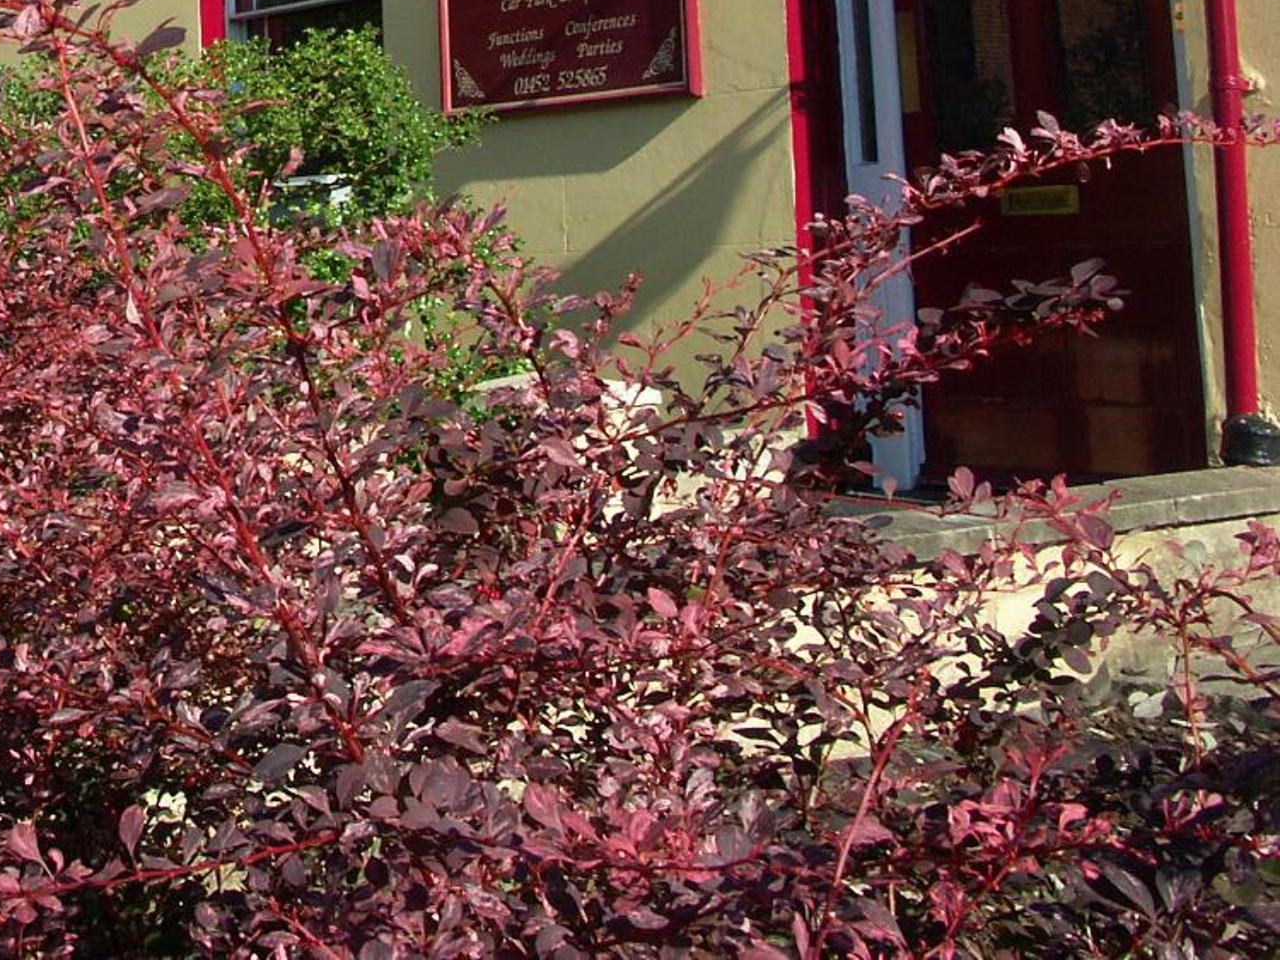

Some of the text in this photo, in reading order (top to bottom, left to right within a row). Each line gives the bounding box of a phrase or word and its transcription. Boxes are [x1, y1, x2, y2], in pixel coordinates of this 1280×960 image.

[487, 12, 636, 51] Functions Conferences
[499, 39, 623, 72] Weddings Parties
[514, 73, 552, 96] 01452
